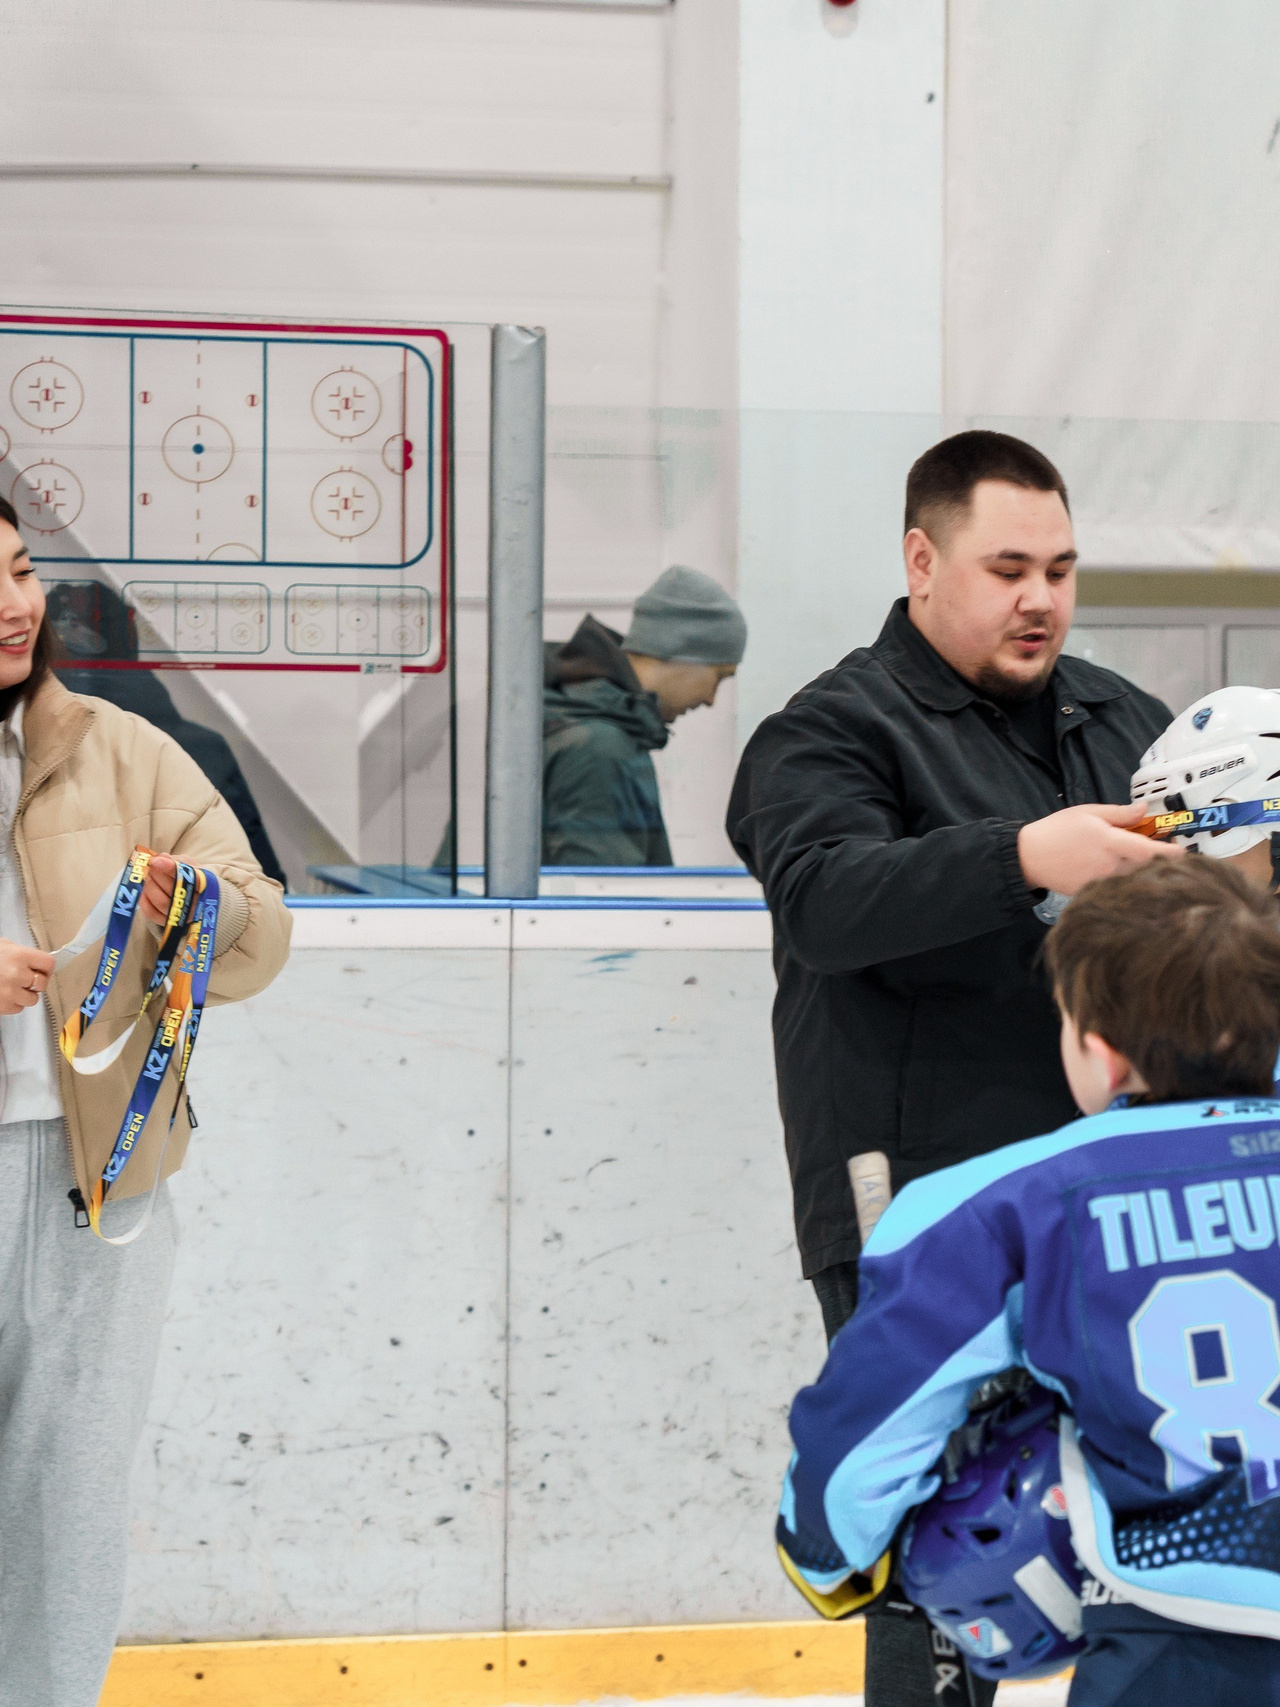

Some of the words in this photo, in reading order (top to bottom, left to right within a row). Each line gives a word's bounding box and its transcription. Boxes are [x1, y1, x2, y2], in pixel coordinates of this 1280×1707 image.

[1199, 756, 1245, 779] BAUER
[1155, 810, 1194, 829] OPEN
[1198, 806, 1229, 828] KZ
[129, 852, 151, 884] OPEN
[113, 885, 138, 917] KZ
[101, 948, 121, 987] OPEN
[196, 934, 210, 973] OPEN
[79, 985, 106, 1018] KZ
[160, 1007, 184, 1048] OPEN
[142, 1048, 169, 1081] KZ
[121, 1112, 145, 1151] OPEN
[101, 1152, 126, 1182] KZ
